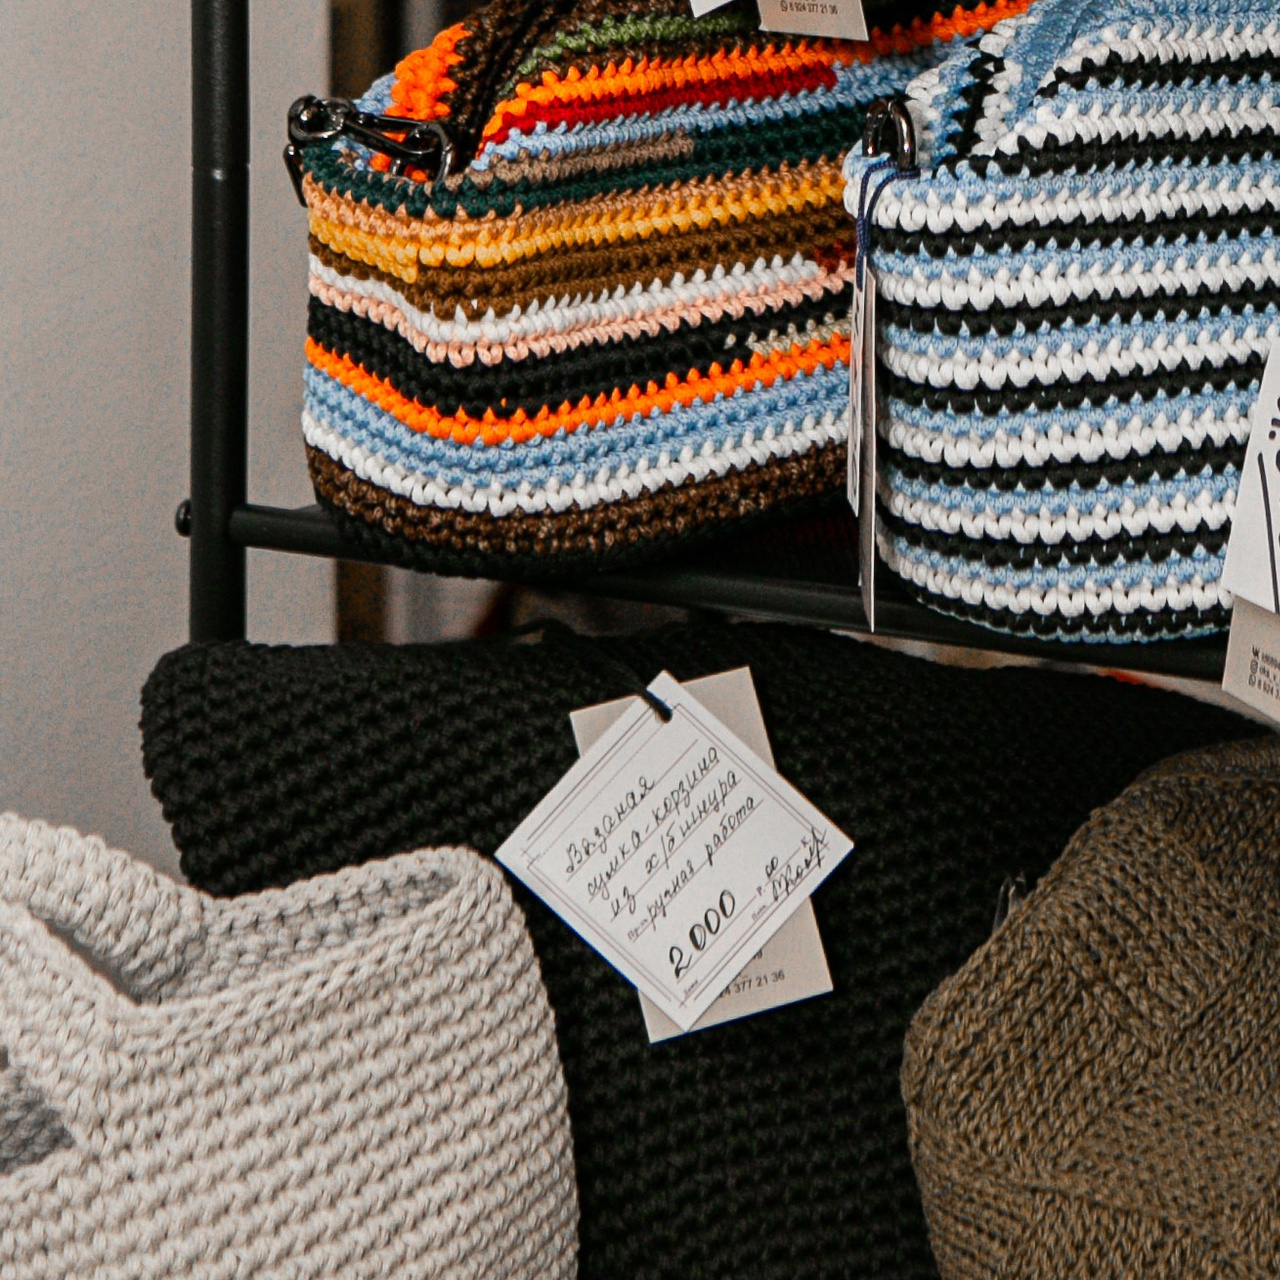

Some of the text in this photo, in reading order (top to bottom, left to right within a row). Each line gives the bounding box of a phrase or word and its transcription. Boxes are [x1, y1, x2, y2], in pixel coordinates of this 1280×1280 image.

[566, 776, 655, 873] Вязаная
[705, 797, 754, 867] работа
[611, 886, 636, 917] из
[669, 889, 735, 979] 2000
[734, 978, 752, 993] 377
[756, 974, 767, 987] 21
[771, 970, 785, 982] 36
